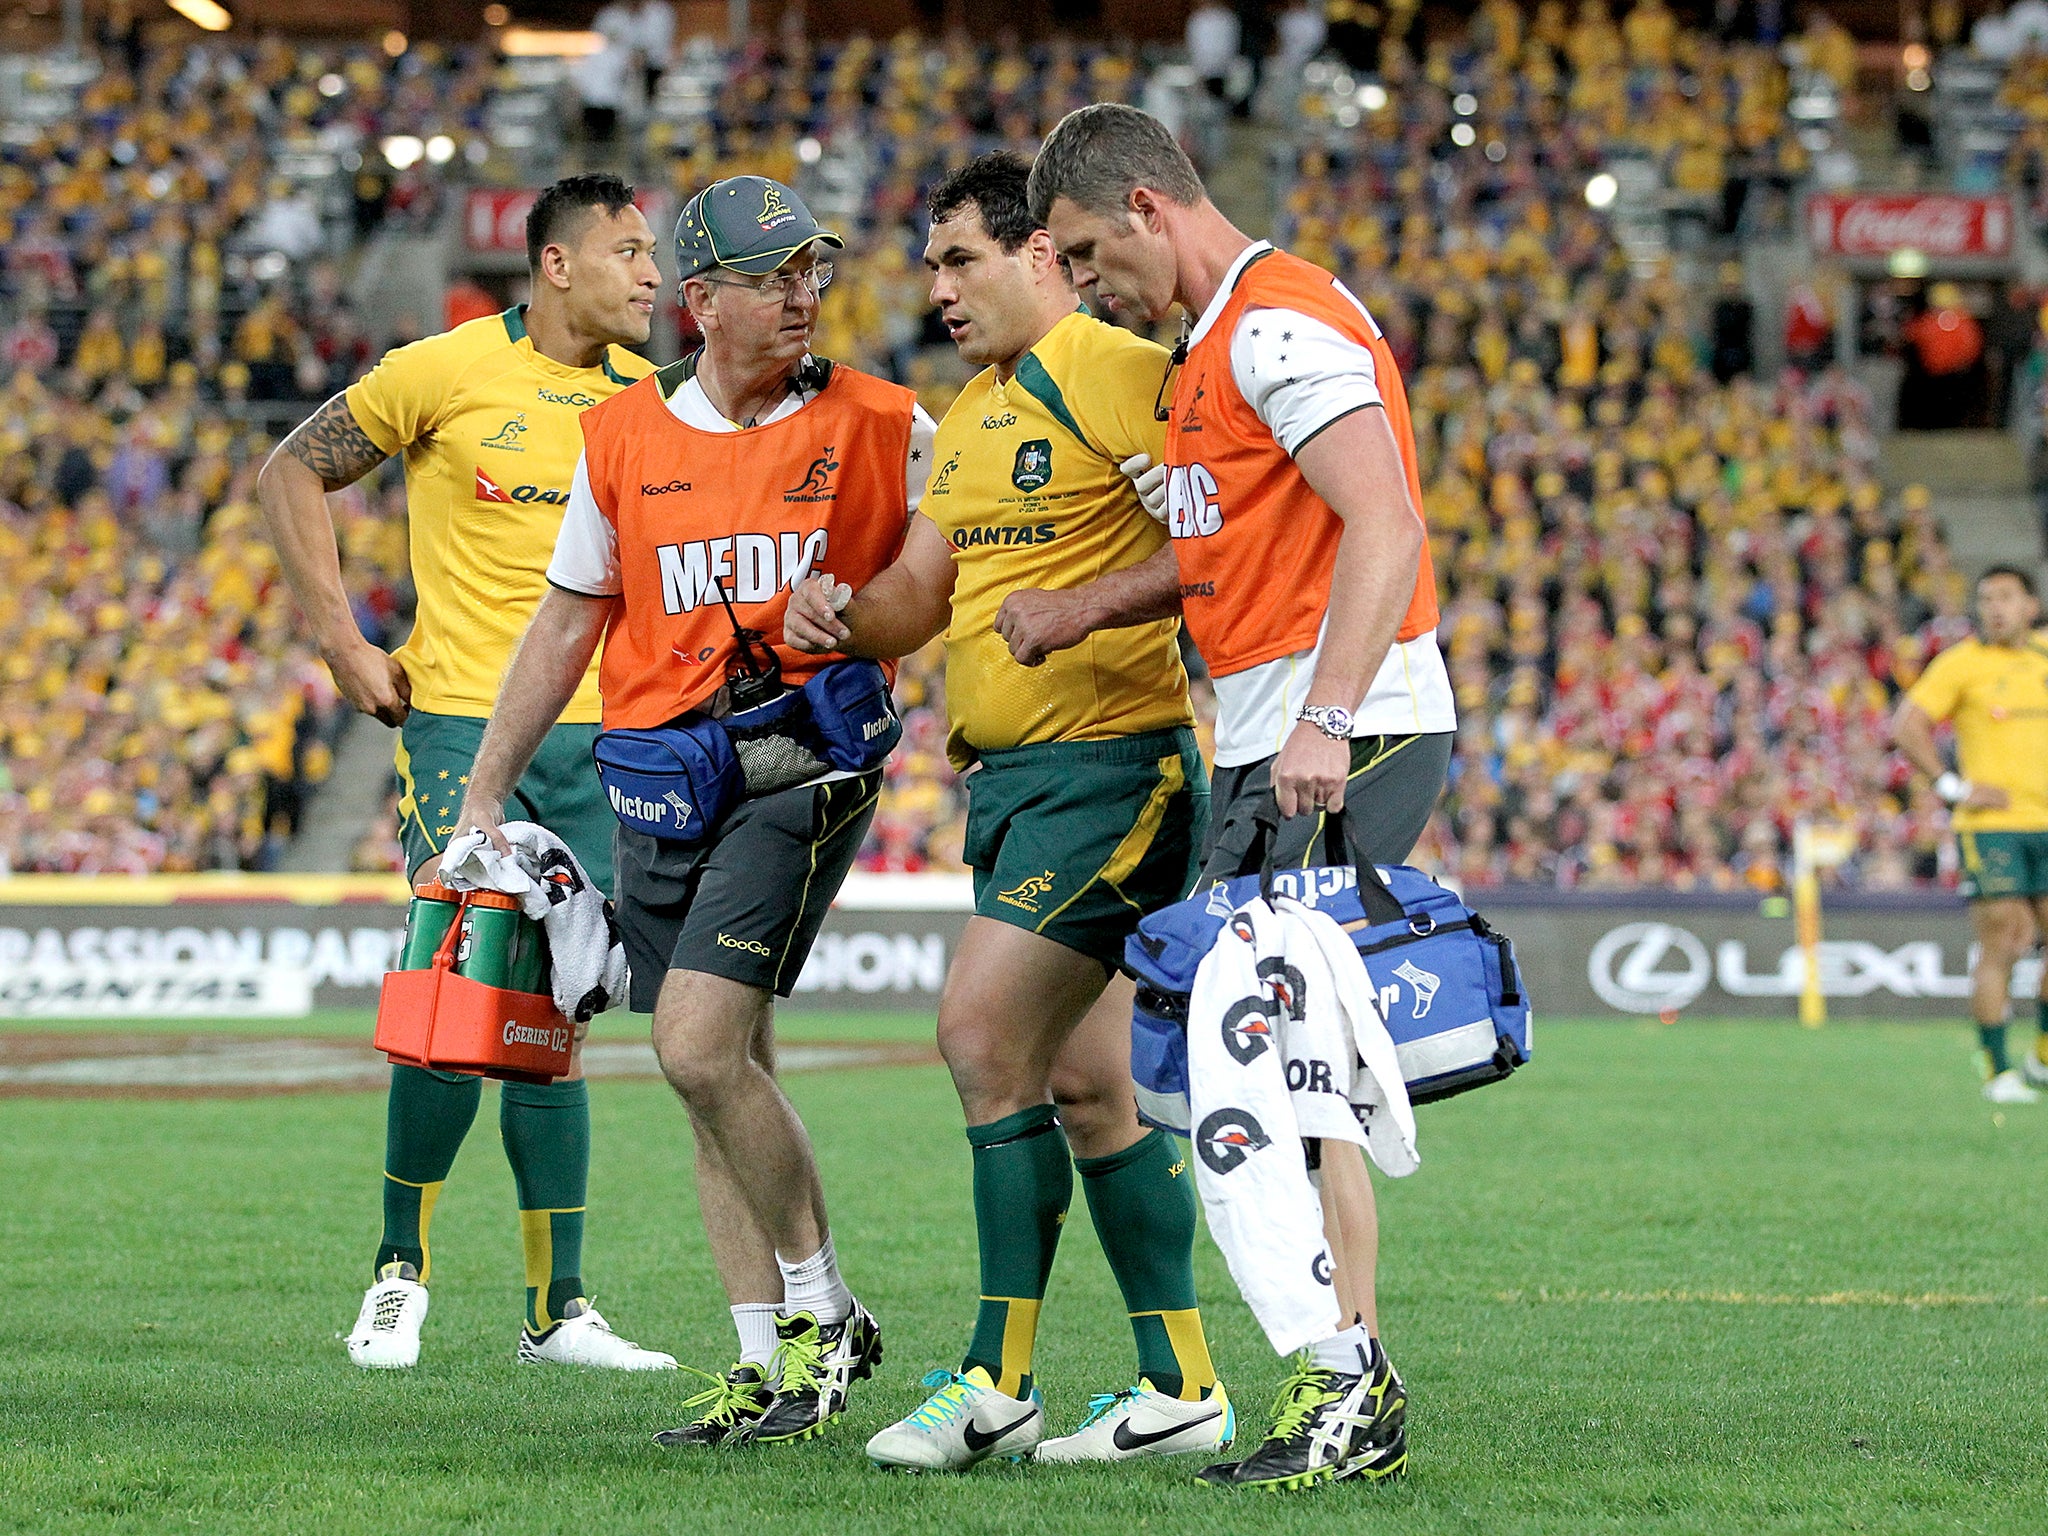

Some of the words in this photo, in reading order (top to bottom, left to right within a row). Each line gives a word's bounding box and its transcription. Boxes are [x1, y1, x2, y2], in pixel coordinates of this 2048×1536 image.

[537, 388, 596, 407] KooGa
[980, 411, 1017, 430] KooGa
[641, 480, 692, 497] KooGa
[783, 493, 838, 503] Wallabies
[953, 522, 1056, 550] QANTAS
[656, 528, 829, 615] MEDIC
[608, 784, 667, 824] Victor
[997, 893, 1040, 914] Wallabies
[717, 932, 770, 957] KooGa
[551, 1028, 569, 1053] 02
